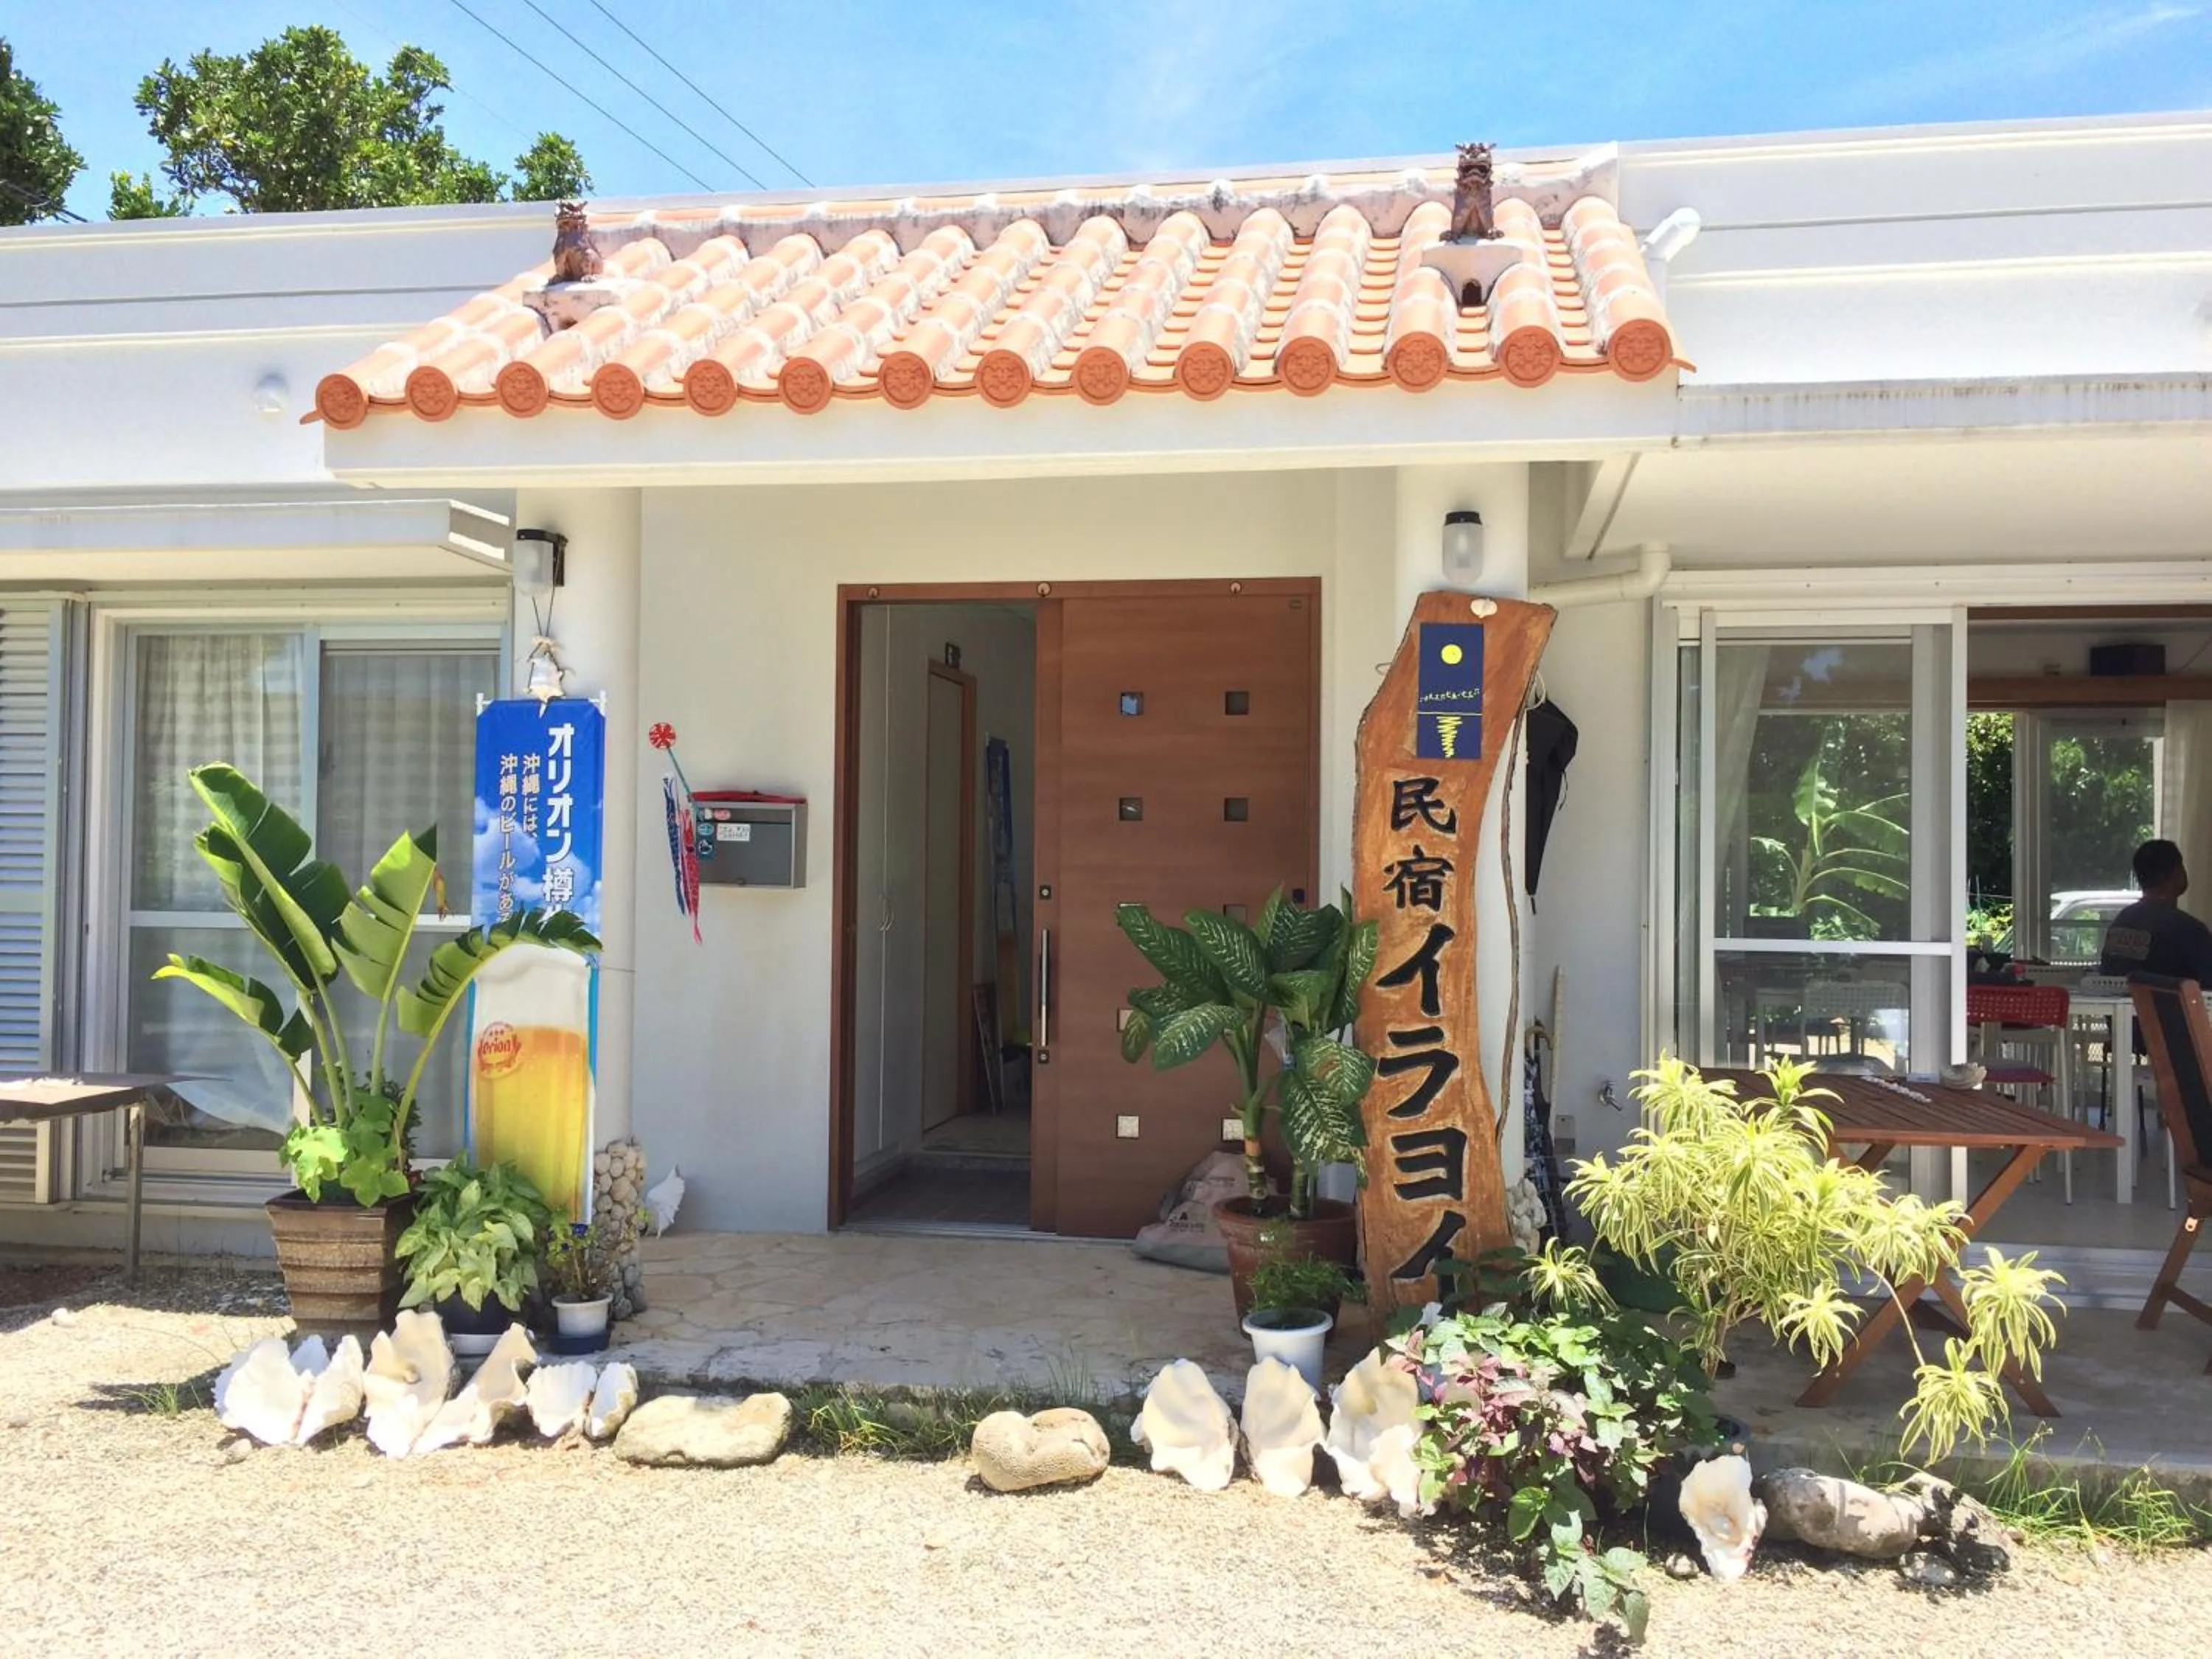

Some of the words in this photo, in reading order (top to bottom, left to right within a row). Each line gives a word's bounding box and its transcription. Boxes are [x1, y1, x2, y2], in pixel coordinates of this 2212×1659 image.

[1375, 776, 1467, 1303] 民宿イラヨイ
